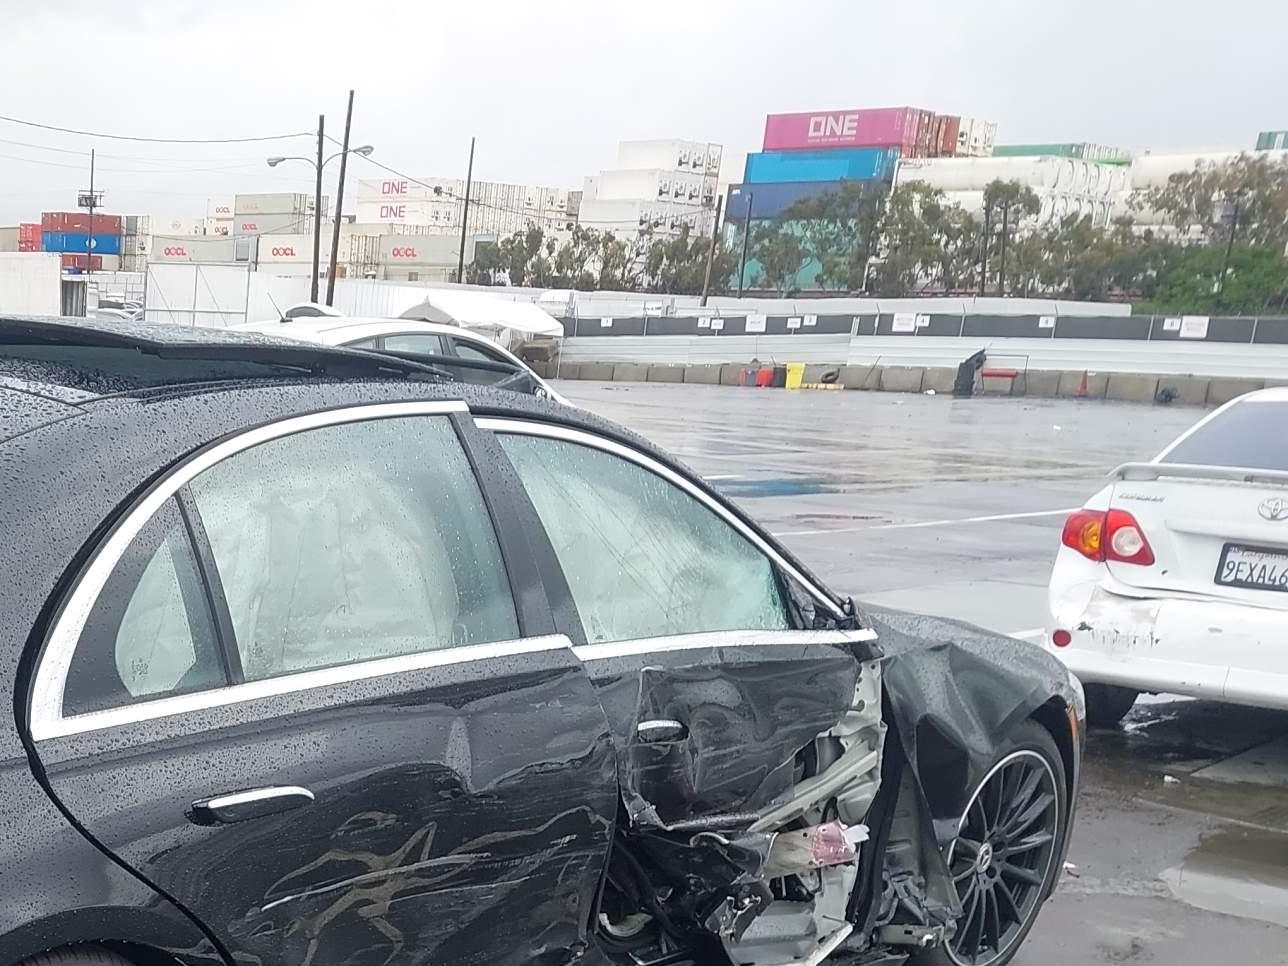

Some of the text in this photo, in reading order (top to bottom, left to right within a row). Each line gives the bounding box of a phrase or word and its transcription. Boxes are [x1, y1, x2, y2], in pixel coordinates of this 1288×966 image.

[808, 114, 858, 136] ONE
[382, 181, 408, 194] ONE
[380, 206, 406, 218] ONE
[164, 247, 188, 256] OOCL
[272, 248, 296, 256] OOCL
[392, 248, 417, 257] OOCL
